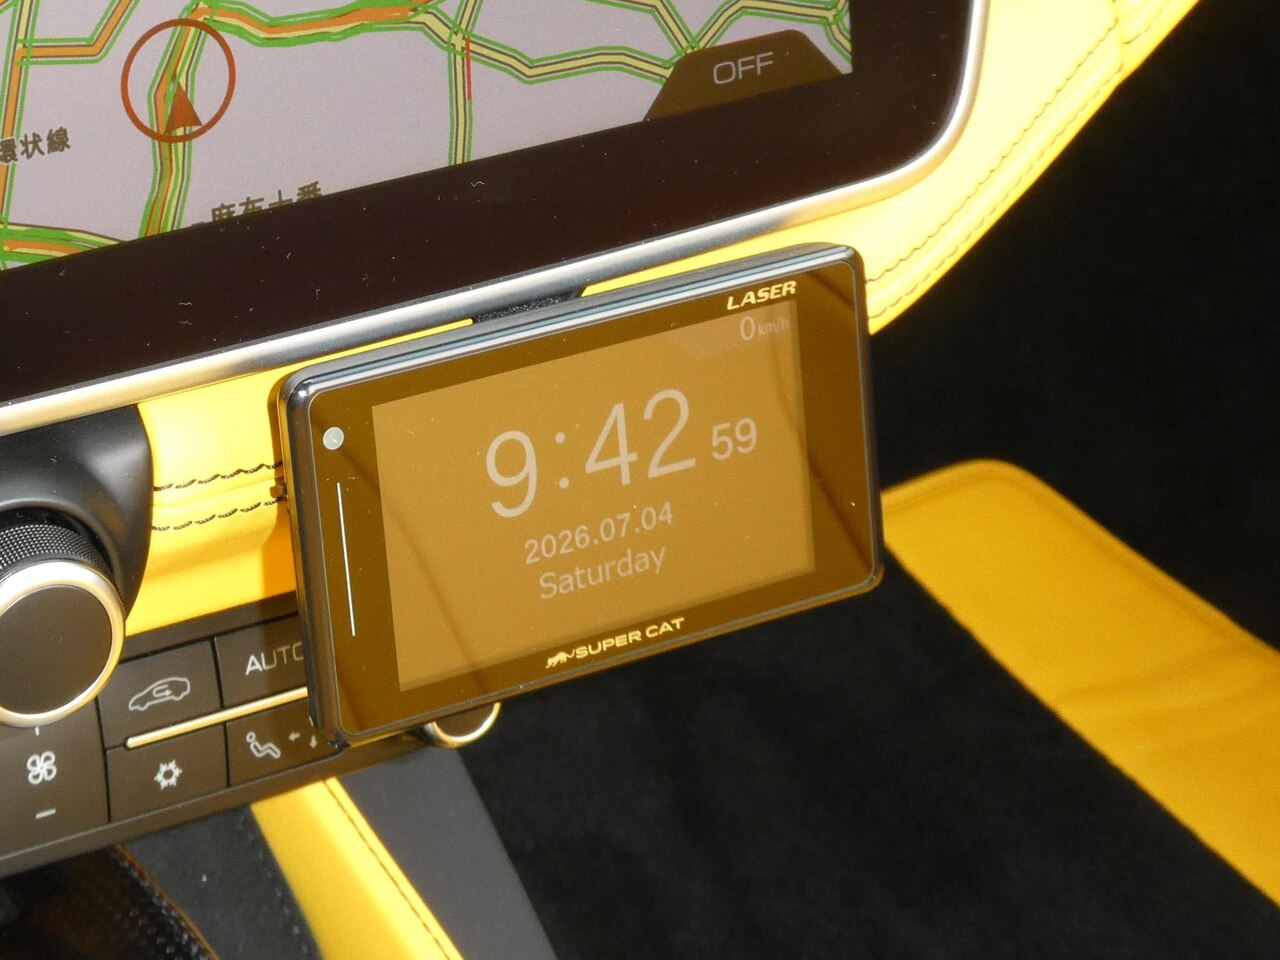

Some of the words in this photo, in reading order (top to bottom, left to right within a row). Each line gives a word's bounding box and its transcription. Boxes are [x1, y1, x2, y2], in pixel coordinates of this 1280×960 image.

[713, 52, 774, 85] OFF
[727, 280, 797, 311] LASER
[740, 315, 756, 341] 0
[485, 388, 696, 518] 9:42
[711, 418, 758, 460] 59
[524, 502, 674, 564] 2026.07.04
[538, 548, 666, 600] Saturday
[575, 631, 642, 658] SUPER
[646, 617, 685, 642] CAT
